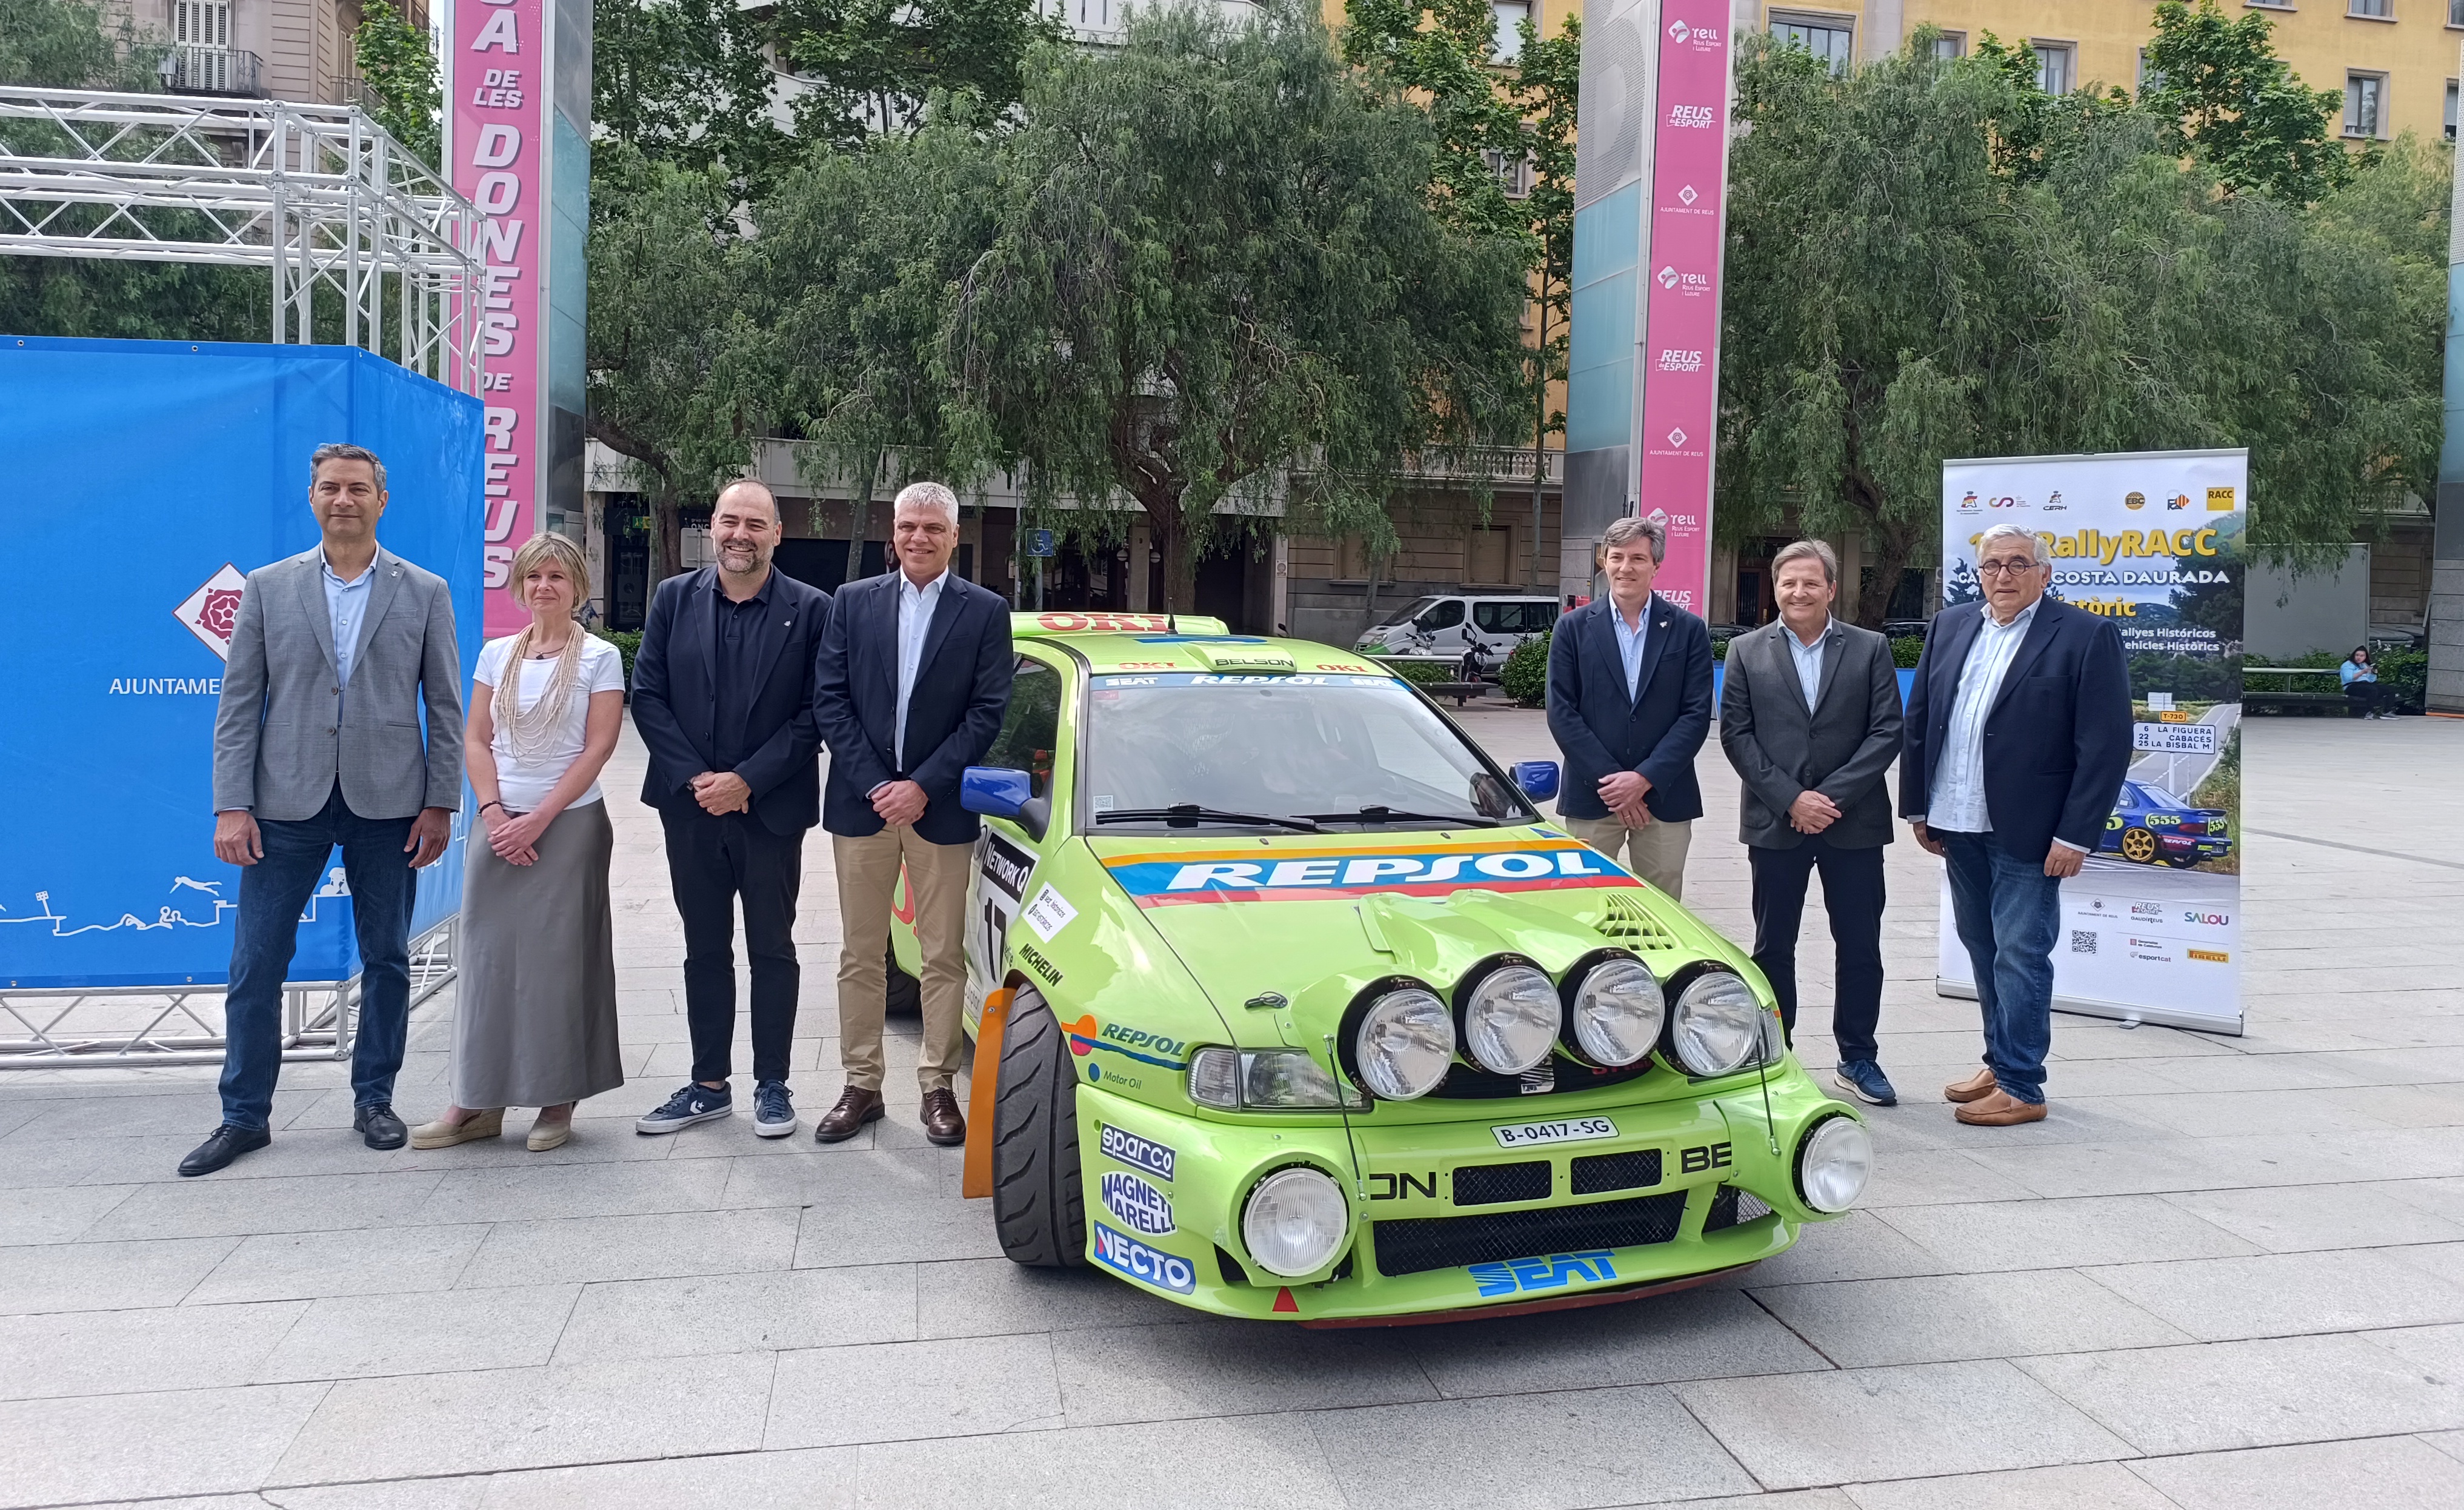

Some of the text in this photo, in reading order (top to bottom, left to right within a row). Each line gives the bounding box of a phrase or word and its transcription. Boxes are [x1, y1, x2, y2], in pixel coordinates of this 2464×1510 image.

[470, 0, 518, 53] A
[483, 68, 520, 88] DE
[472, 87, 522, 108] LES
[1671, 105, 1713, 121] REUS
[1674, 118, 1714, 128] ESPORT
[471, 123, 523, 355] DONES
[1660, 349, 1702, 364] REUS
[1663, 362, 1702, 372] ESPORT
[484, 371, 512, 391] DE
[484, 407, 518, 588] REUS
[2208, 490, 2233, 499] RACC
[2051, 570, 2231, 585] COSTA DAURADA
[2057, 596, 2137, 617] tòric
[1037, 613, 1168, 631] OKI
[2120, 627, 2217, 639] allyes Históricos
[2123, 640, 2165, 651] ehicles
[1214, 659, 1294, 668] BELSON
[109, 678, 224, 695] AJUNTAME
[1105, 677, 1159, 687] SEAT
[1190, 676, 1329, 686] REPSOL
[2169, 734, 2212, 743] CABACÉS
[2173, 727, 2212, 735] FIGUERA
[2149, 815, 2182, 825] 555
[983, 841, 1030, 896] NETWORK Q
[1165, 851, 1601, 891] REPSOL
[2135, 902, 2160, 910] REUS
[2184, 911, 2229, 926] SALOU
[984, 897, 1007, 983] 17
[1019, 943, 1064, 988] MICHELIN
[2138, 953, 2171, 963] esportcat
[2189, 950, 2226, 962] PIRELLI
[1102, 1023, 1185, 1057] REPSOL
[1104, 1070, 1142, 1090] Motor Oil
[1500, 1119, 1610, 1143] B-0417-SG
[1102, 1127, 1173, 1172] sparco
[1101, 1173, 1173, 1218] MAGNETI
[1101, 1192, 1176, 1234] MARELLI
[1096, 1226, 1191, 1288] NECTO
[1468, 1248, 1615, 1297] SEAT
